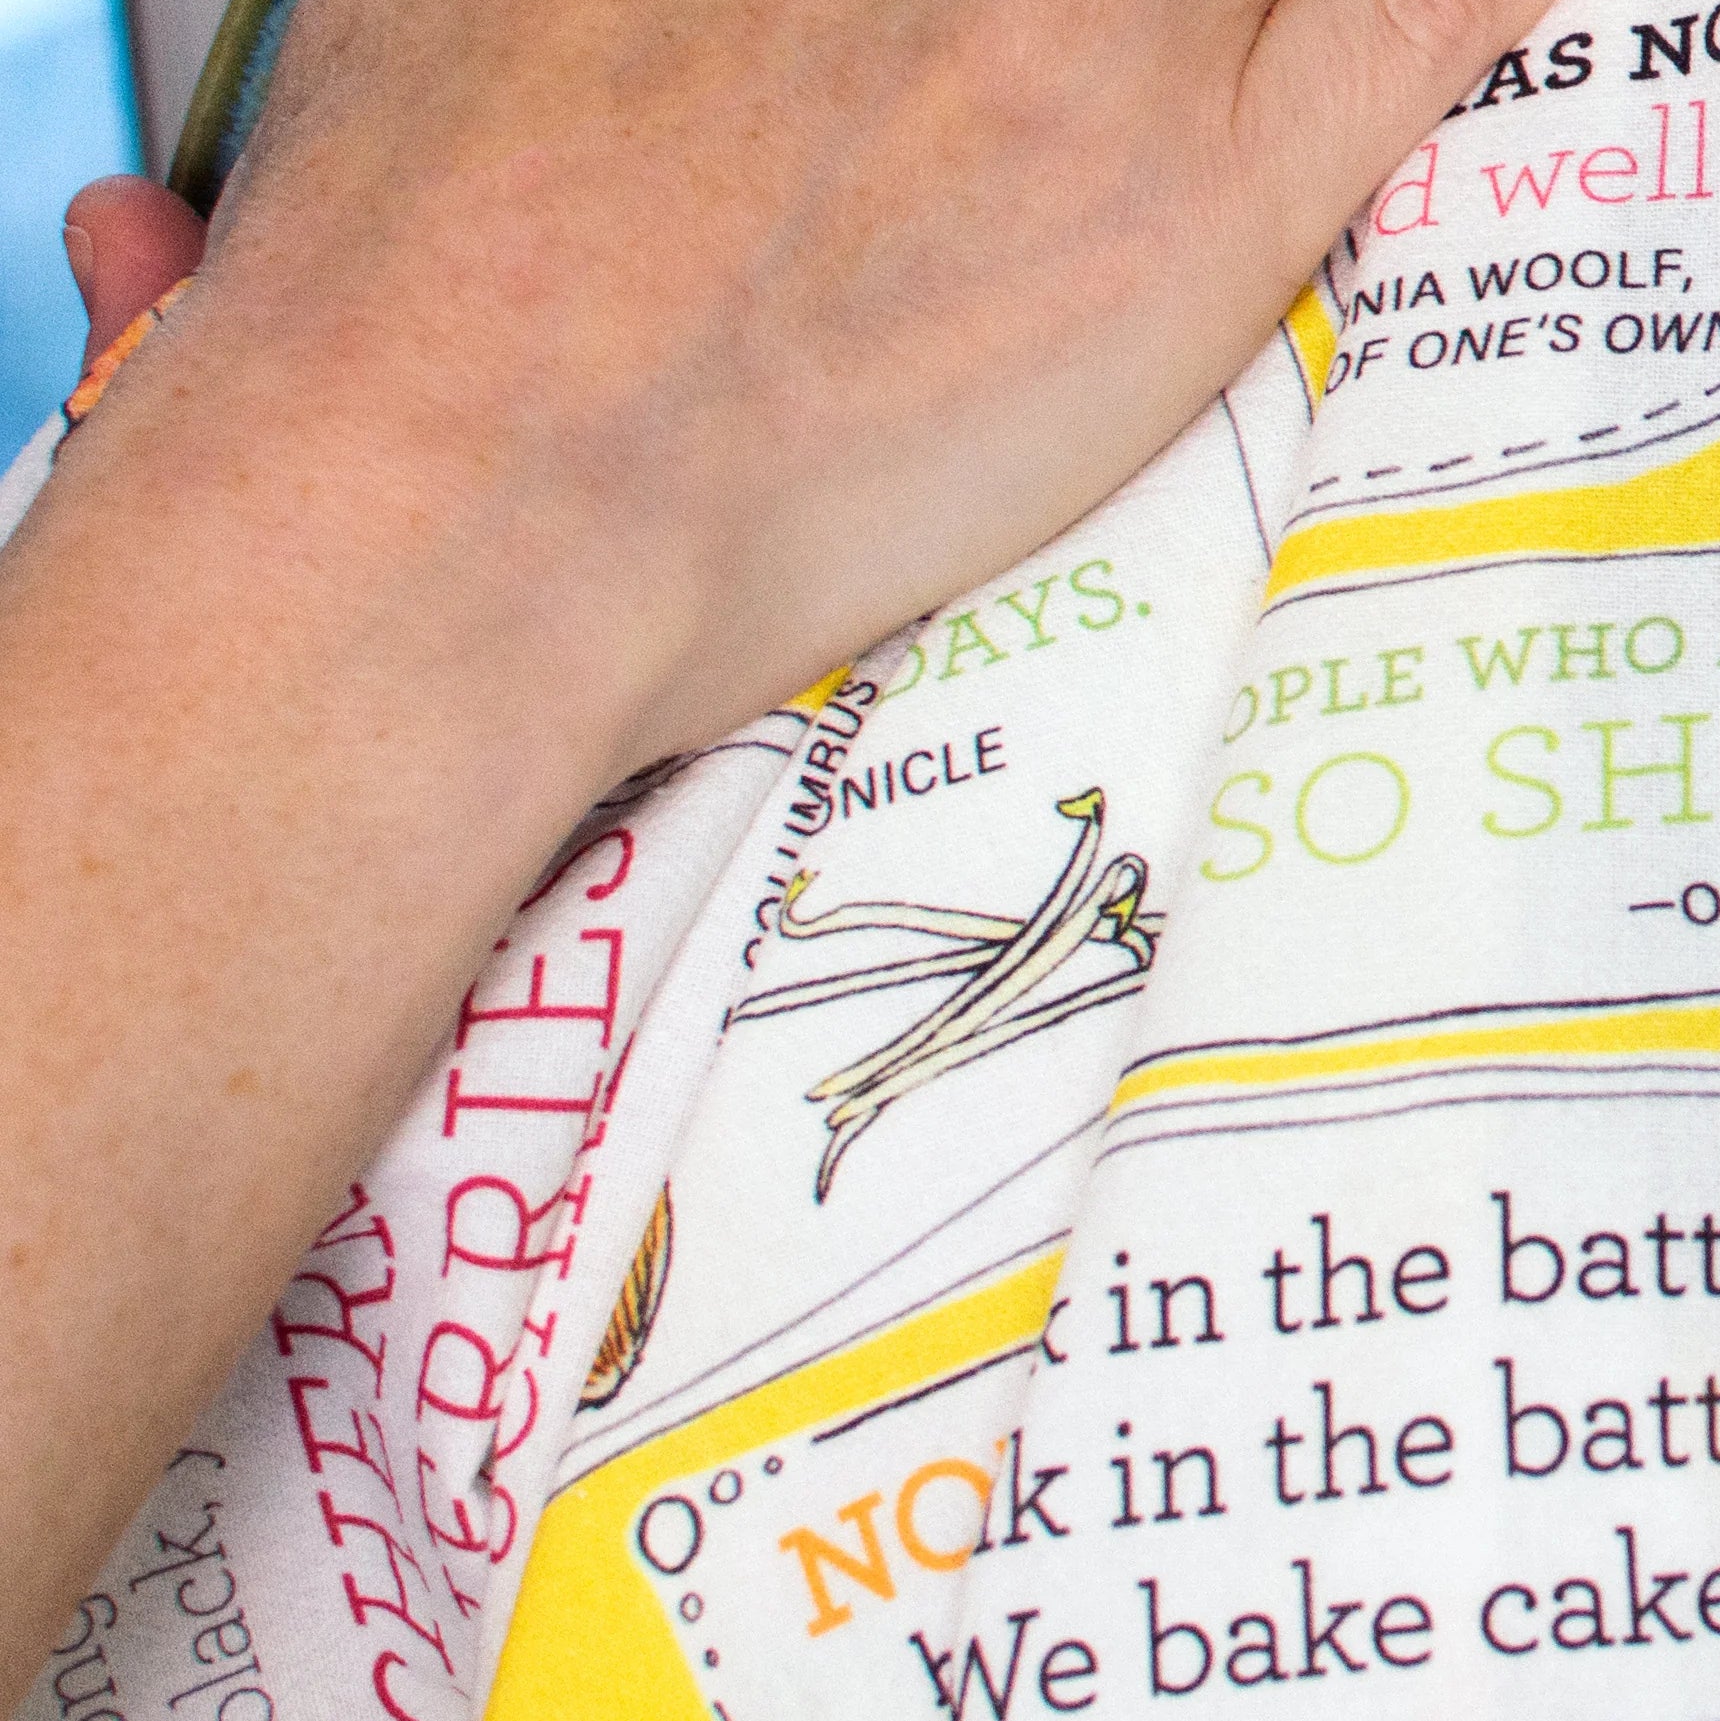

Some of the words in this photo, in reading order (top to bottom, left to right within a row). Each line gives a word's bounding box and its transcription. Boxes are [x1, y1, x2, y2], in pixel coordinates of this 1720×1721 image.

[1442, 33, 1594, 119] AS
[1468, 248, 1693, 301] WOOLF,
[1456, 615, 1687, 692] WHO
[1200, 751, 1410, 885] SO
[1108, 1251, 1223, 1353] in
[1263, 1213, 1449, 1334] the
[1110, 1422, 1228, 1528] in
[1265, 1381, 1453, 1507] the
[778, 1440, 1006, 1638] NO
[1139, 1558, 1434, 1696] bake
